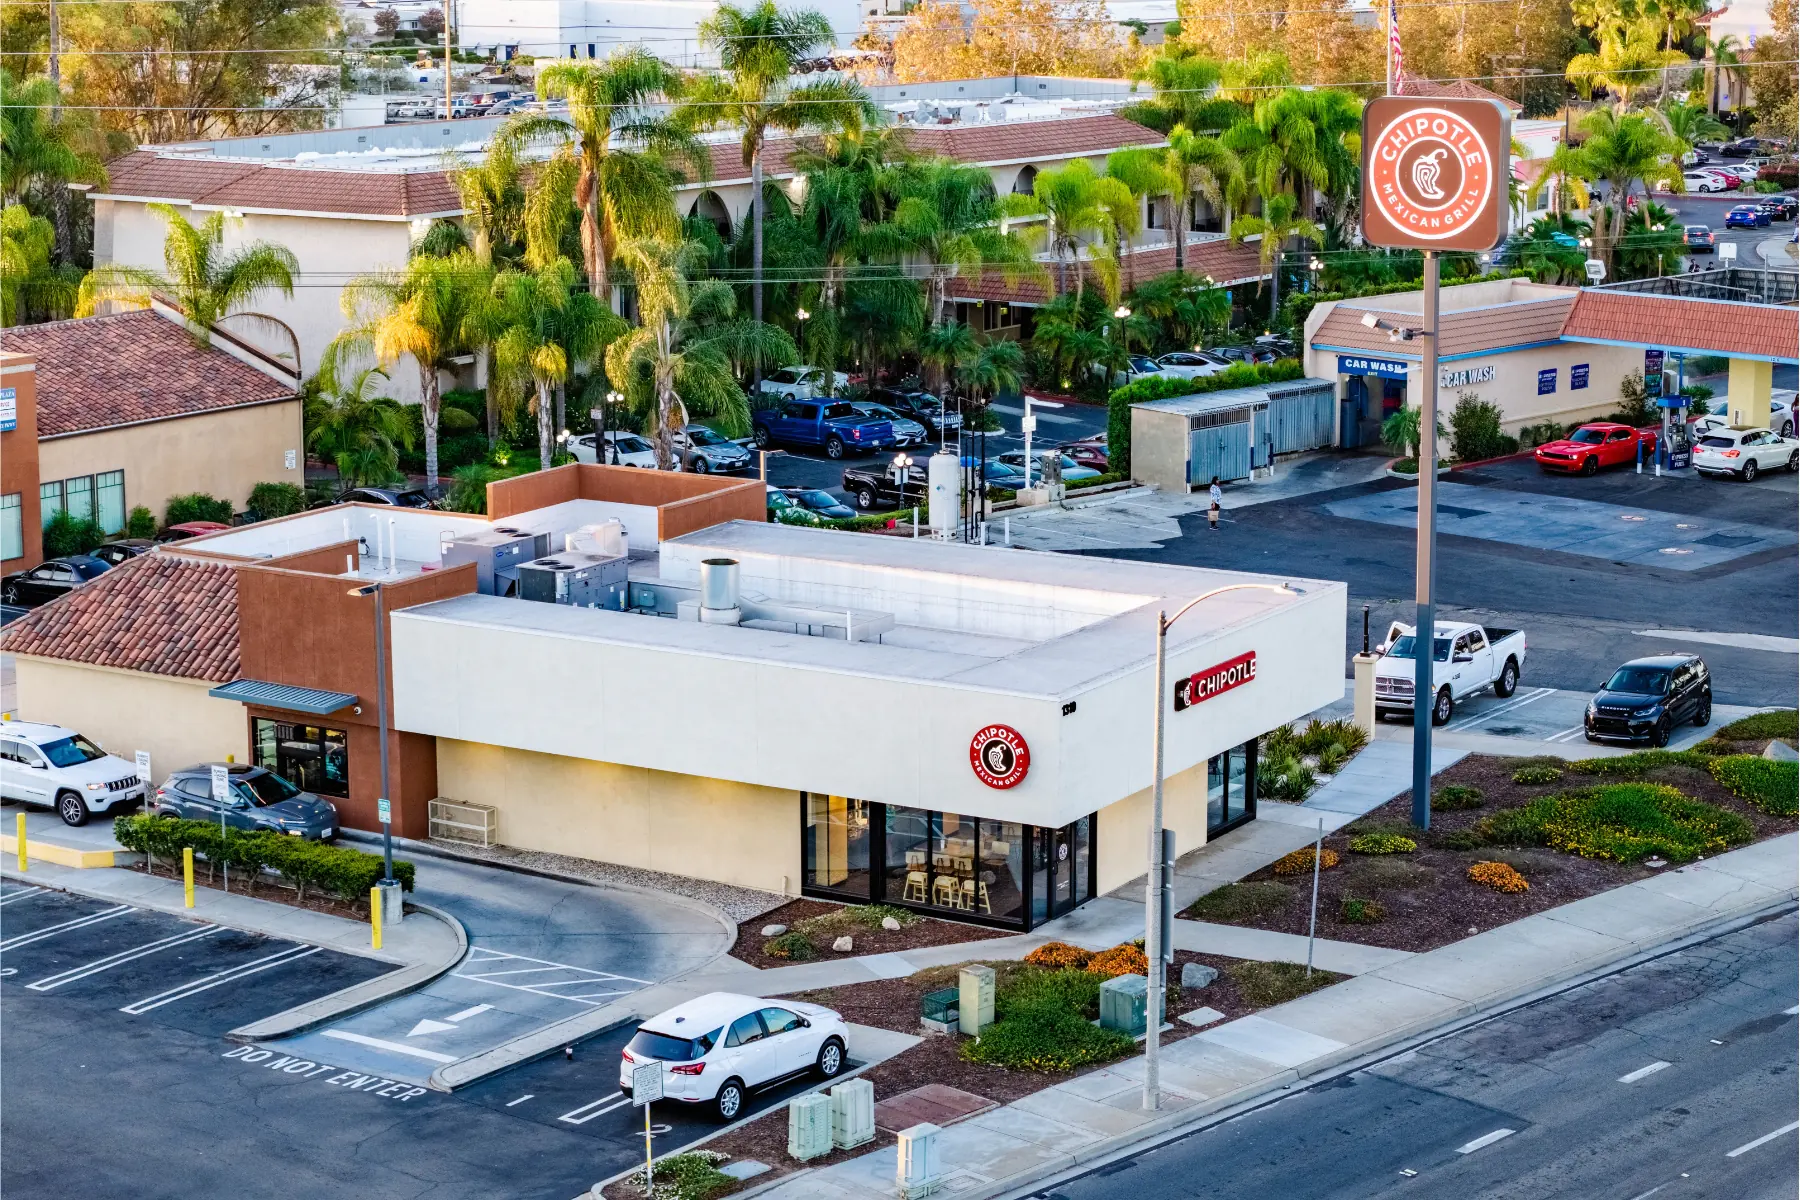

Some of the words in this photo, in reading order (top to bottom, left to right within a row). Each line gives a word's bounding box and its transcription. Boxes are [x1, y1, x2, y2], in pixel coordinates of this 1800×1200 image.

[1382, 118, 1482, 167] CHIPOTLE
[1383, 183, 1440, 227] MEXICAN
[1444, 189, 1479, 224] GRILL
[1345, 359, 1368, 369] CAR
[1370, 361, 1402, 372] WASH
[1447, 371, 1467, 388] CAR
[1469, 366, 1496, 384] WASH
[1198, 658, 1257, 698] CHIPOTLE
[973, 728, 1025, 756] CHIPOTLE
[974, 760, 1004, 786] MEXICAN
[1004, 767, 1023, 785] GRILL
[221, 1045, 273, 1063] DO
[264, 1056, 336, 1078] NOT
[324, 1071, 428, 1102] ENTER
